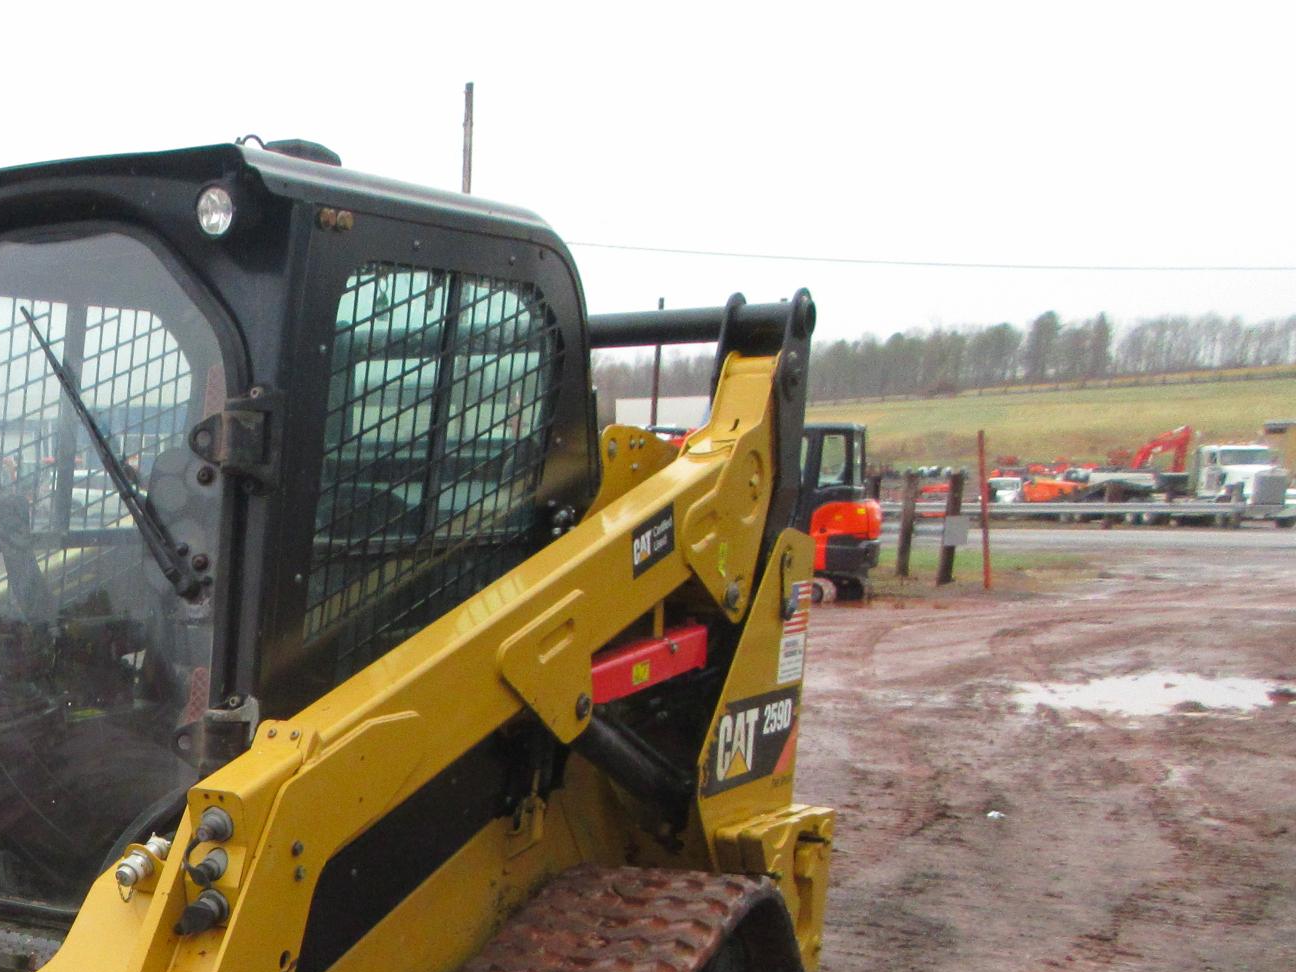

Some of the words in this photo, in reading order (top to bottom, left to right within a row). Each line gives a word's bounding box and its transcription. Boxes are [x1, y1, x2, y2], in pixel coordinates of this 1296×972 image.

[633, 529, 653, 566] CAT
[716, 707, 760, 782] CAT
[762, 698, 793, 735] 259D
